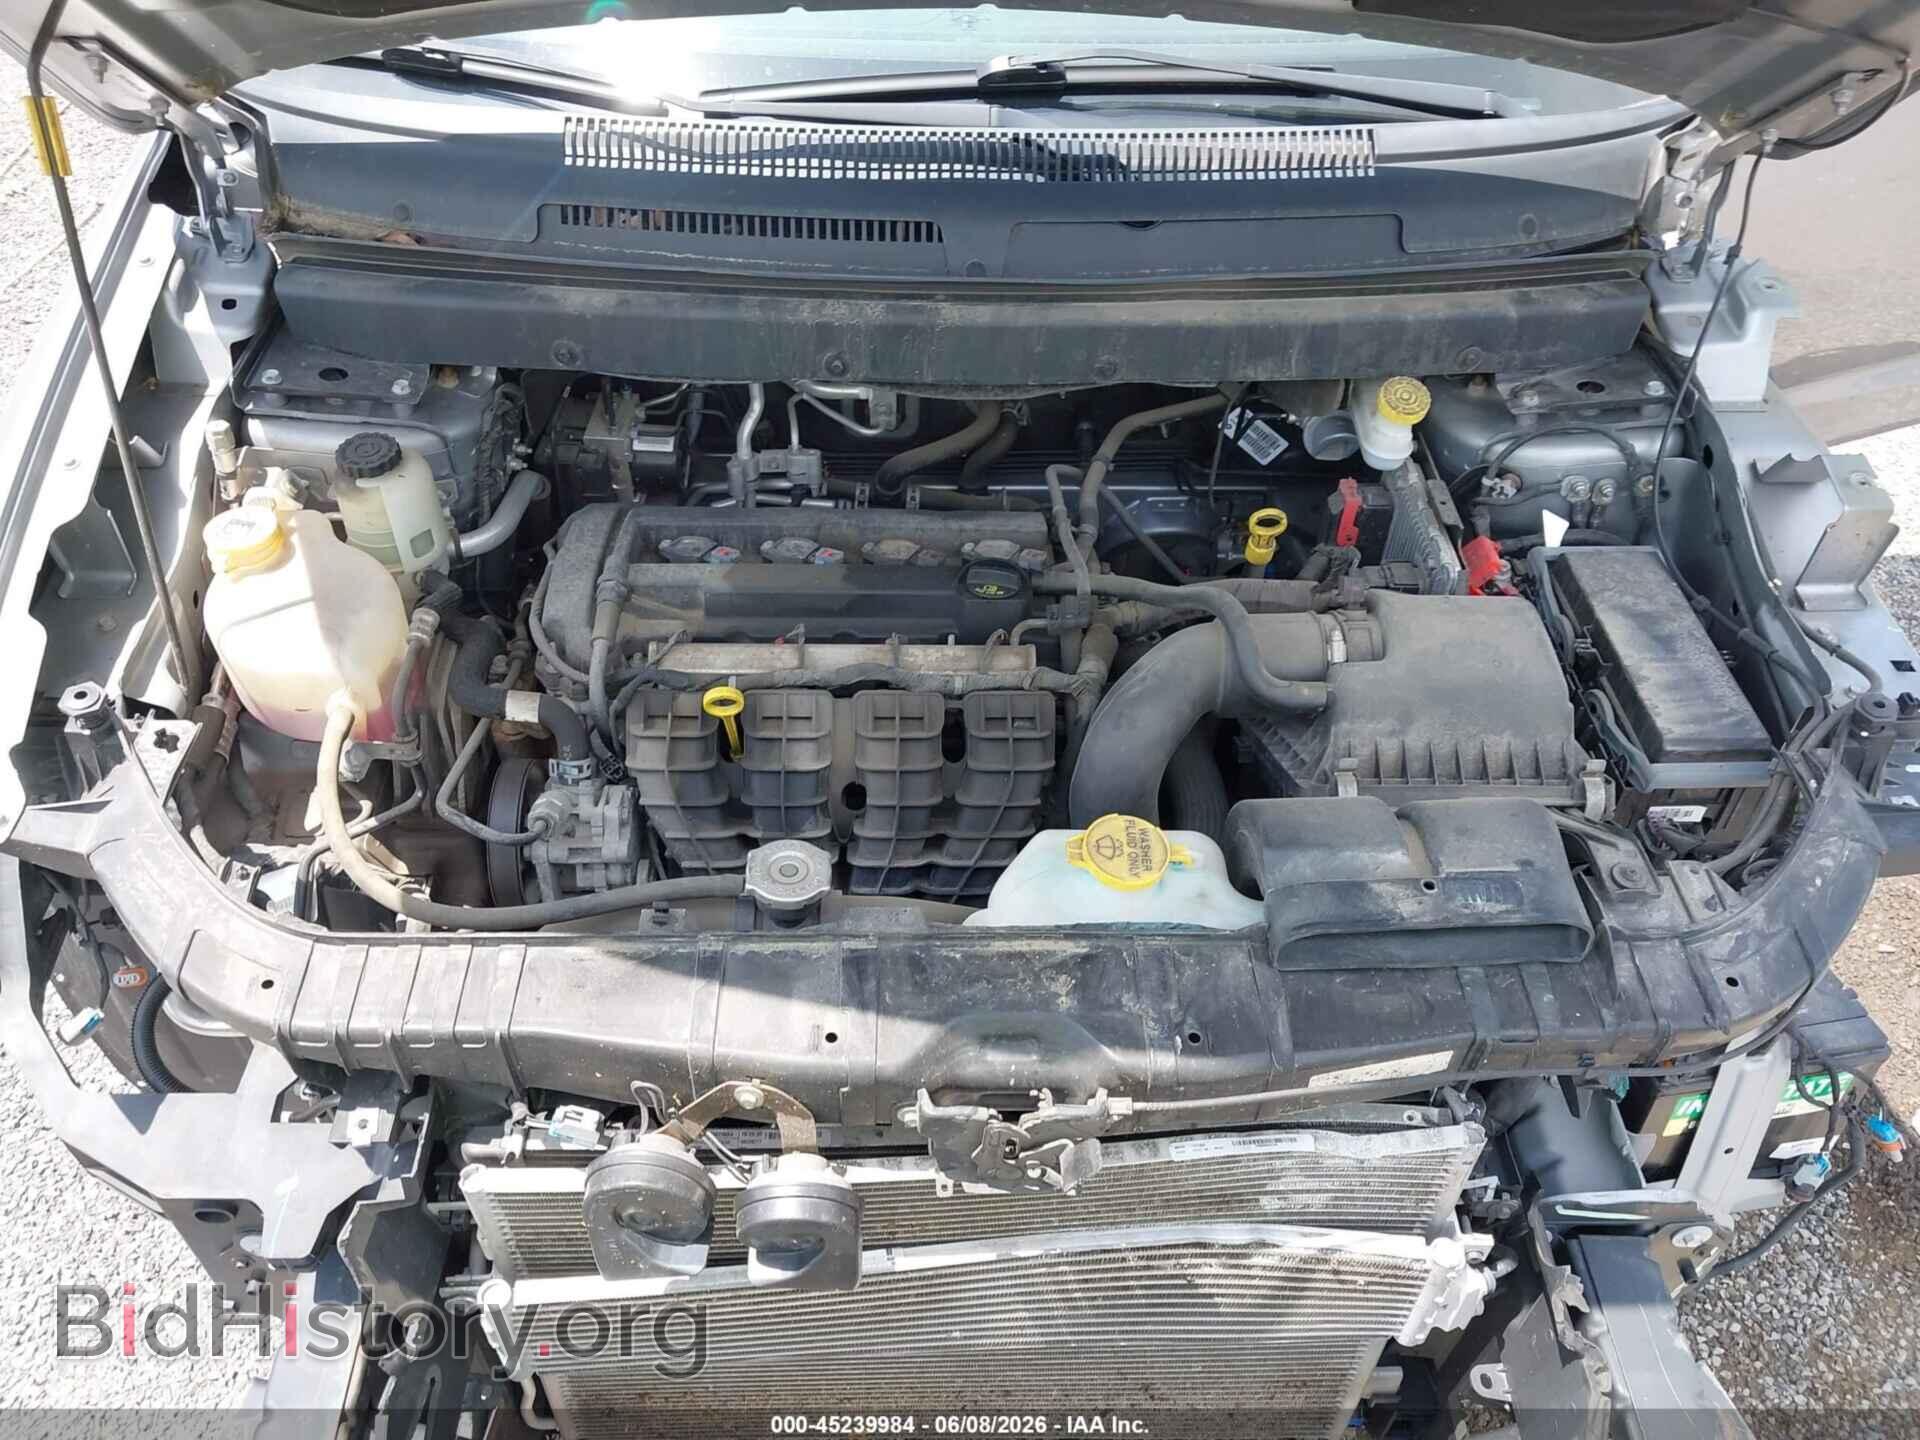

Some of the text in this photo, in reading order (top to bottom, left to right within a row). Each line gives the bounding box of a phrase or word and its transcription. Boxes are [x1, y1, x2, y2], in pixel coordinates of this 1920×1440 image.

[1126, 819, 1141, 879] FLUID ONLY
[1138, 827, 1152, 872] WASHER
